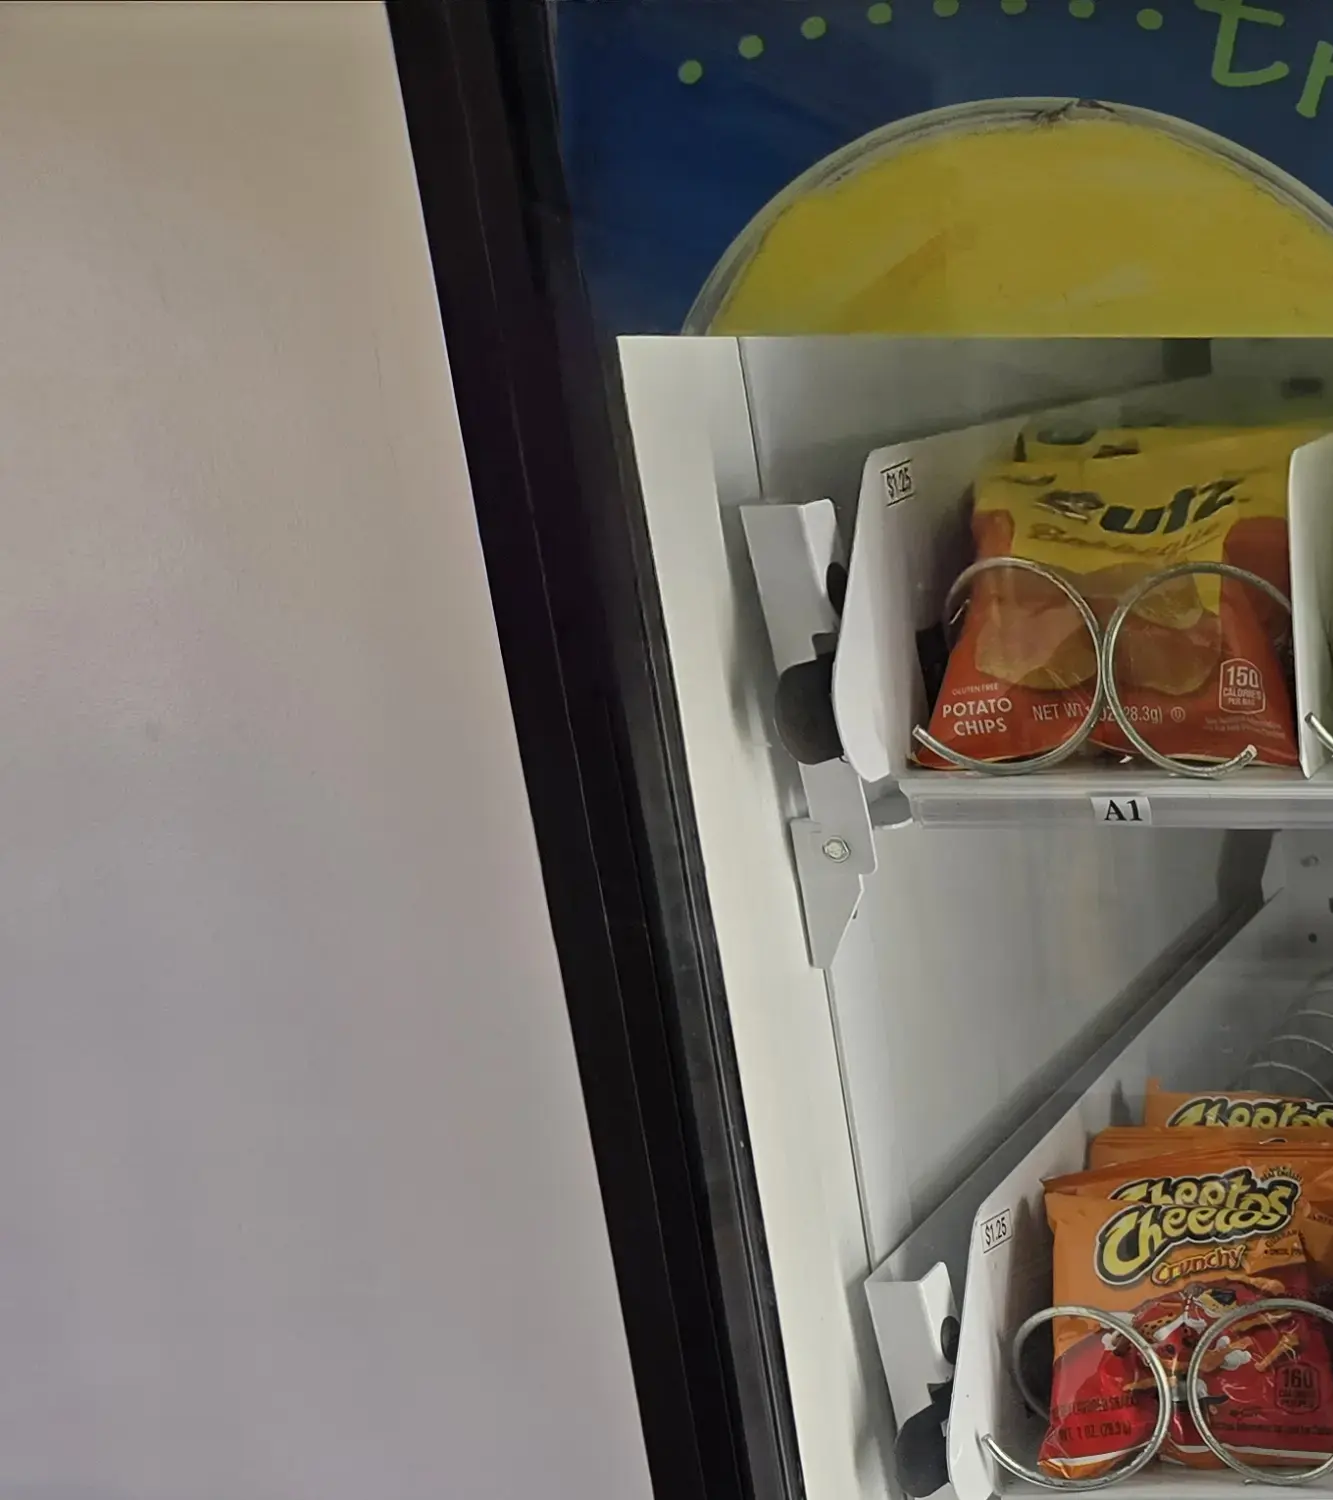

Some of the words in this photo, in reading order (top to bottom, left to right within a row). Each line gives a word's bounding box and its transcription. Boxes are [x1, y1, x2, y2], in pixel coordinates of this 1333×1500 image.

[1226, 664, 1260, 688] 150
[942, 696, 1013, 719] POTATO
[1032, 704, 1059, 722] NET
[952, 718, 1007, 737] CHIPS
[1104, 799, 1143, 822] A1
[983, 1216, 1008, 1248] $1.25
[1152, 1244, 1246, 1287] Crunchy
